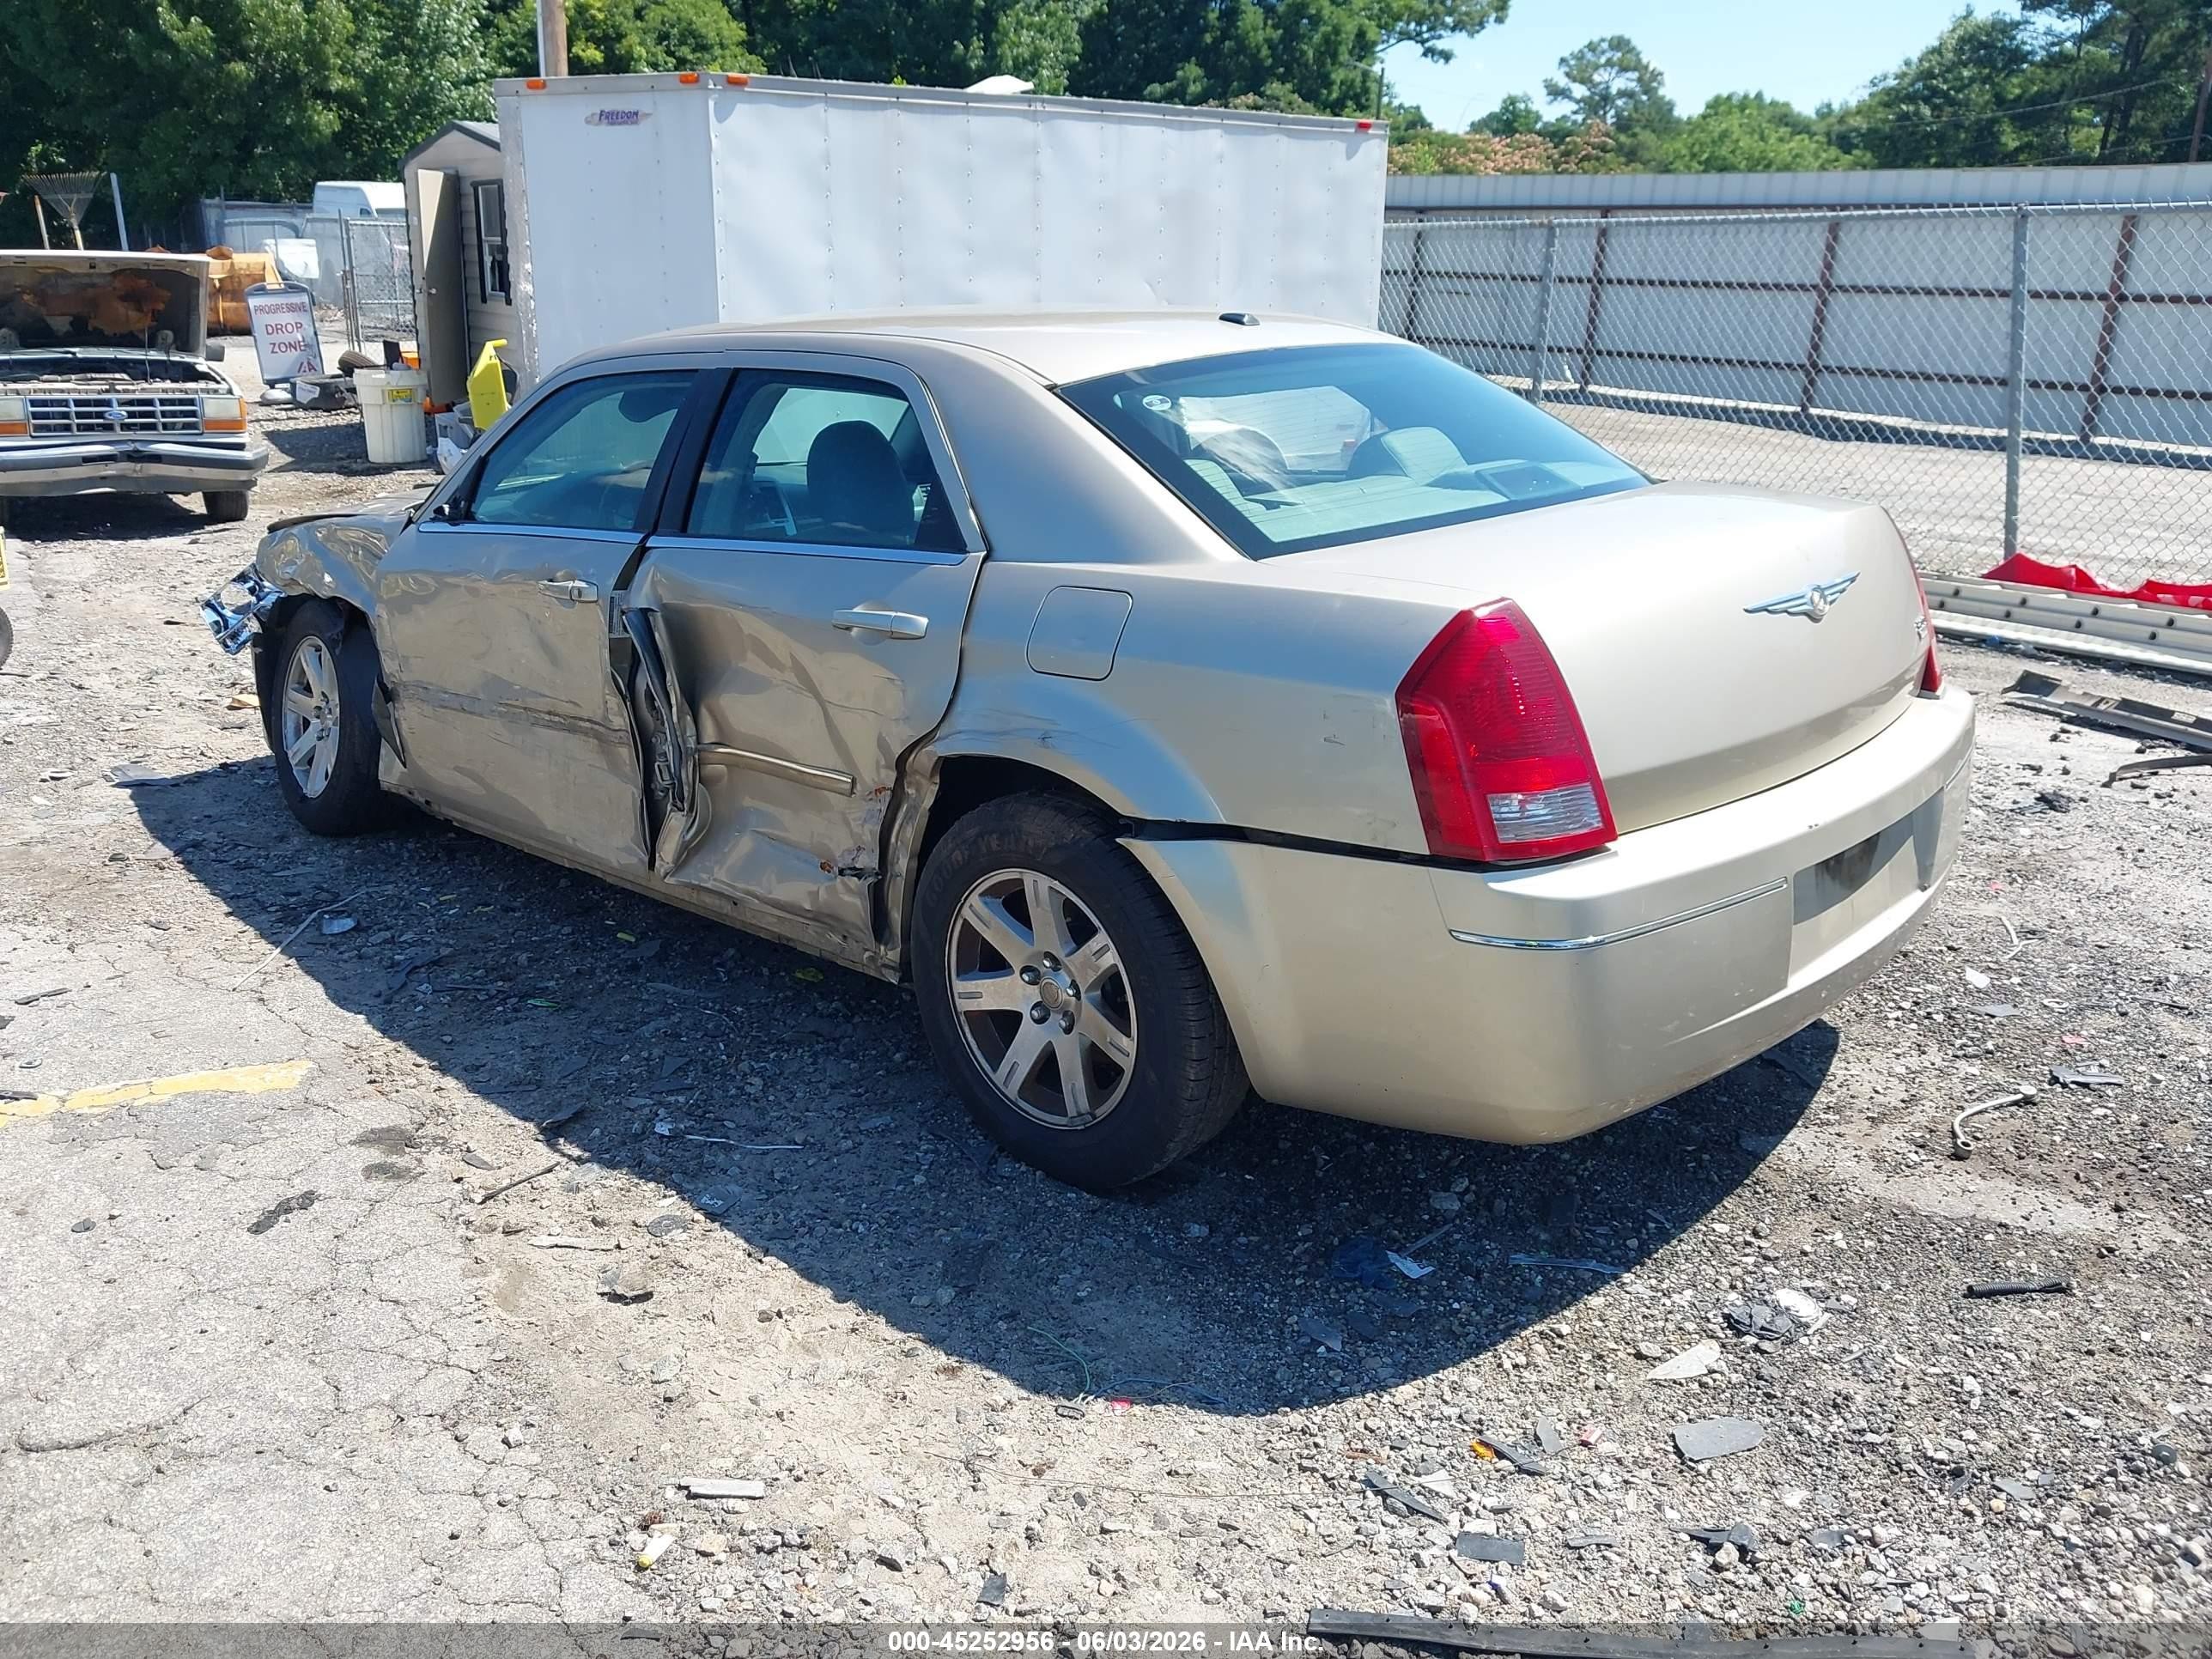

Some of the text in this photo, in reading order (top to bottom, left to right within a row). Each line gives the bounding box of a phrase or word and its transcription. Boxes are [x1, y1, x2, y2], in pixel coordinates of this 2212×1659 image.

[253, 301, 308, 316] PROGRESSIVE
[264, 321, 303, 336] DROP
[269, 340, 307, 355] ZONE
